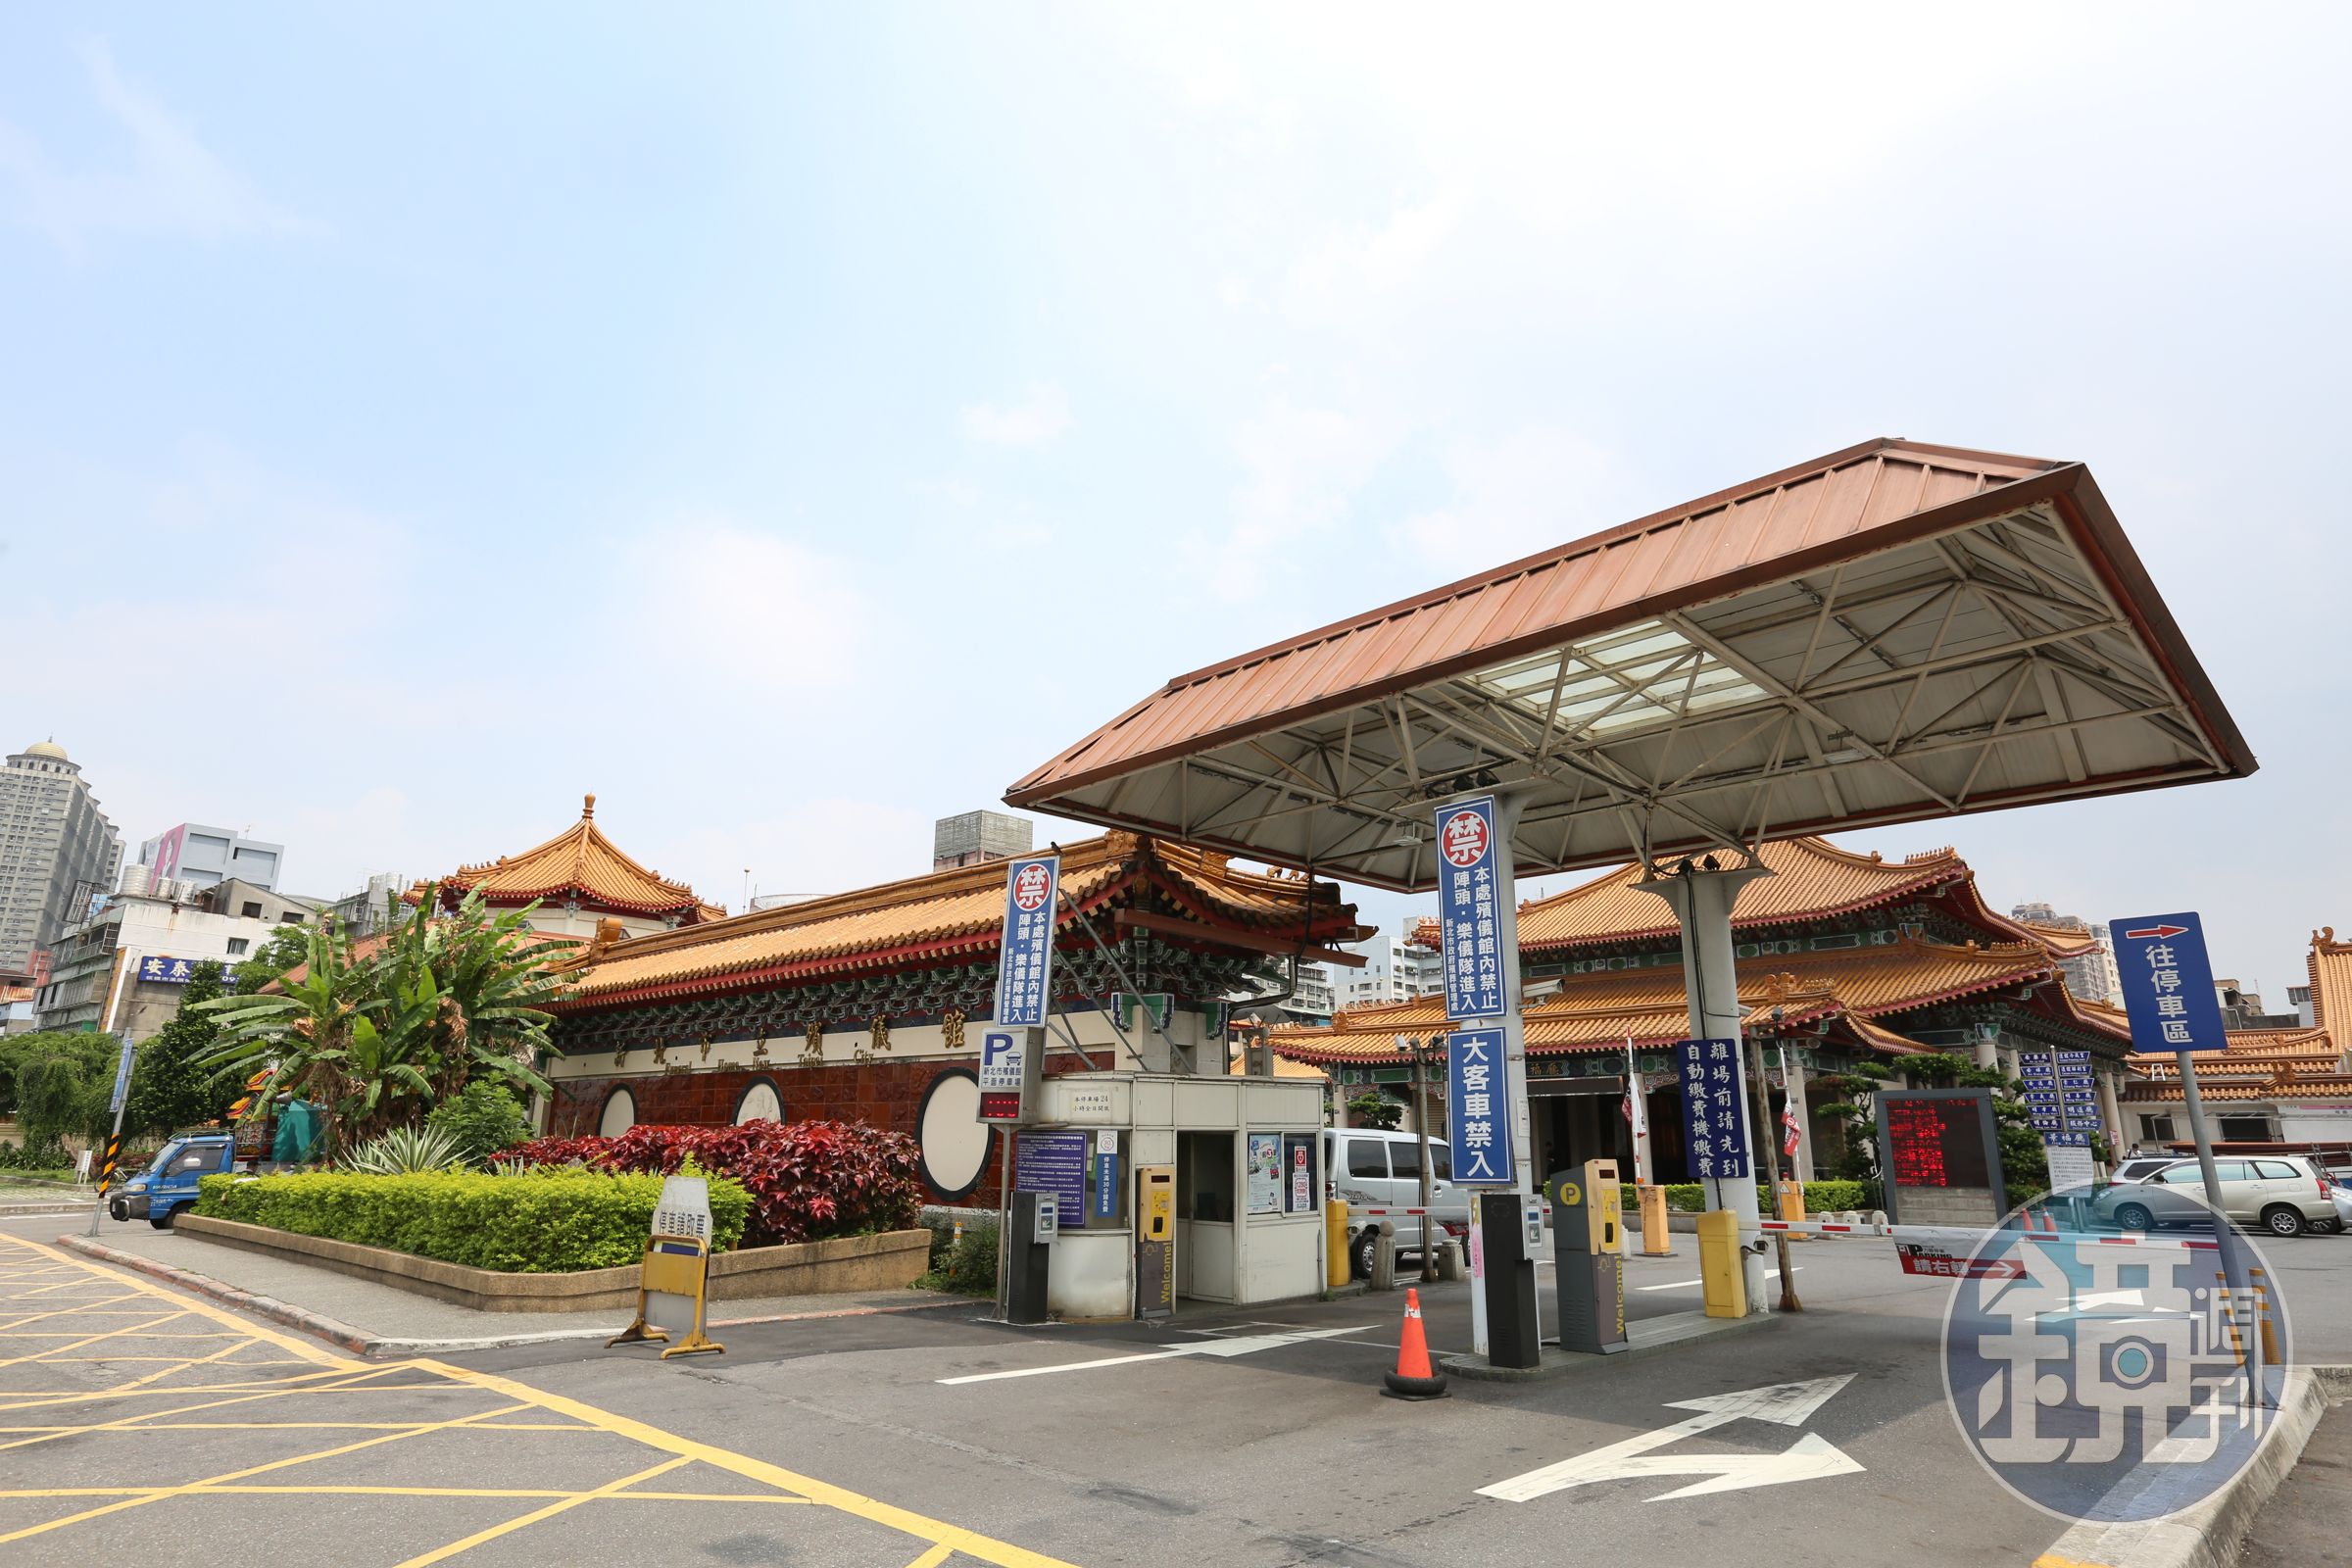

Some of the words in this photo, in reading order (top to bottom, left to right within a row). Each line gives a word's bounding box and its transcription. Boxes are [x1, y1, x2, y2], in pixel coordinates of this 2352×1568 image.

[1448, 815, 1482, 862] 禁
[1019, 867, 1046, 906] 禁
[1025, 911, 1046, 1022] 本處殯儀館內禁止
[1474, 866, 1498, 1009] 本處殯儀館內禁止
[2145, 944, 2193, 1043] 往停車區
[984, 1034, 1013, 1066] P
[1462, 1036, 1494, 1177] 大客車禁入
[1687, 1044, 1715, 1177] 自動繳費機繳費
[1709, 1042, 1740, 1177] 離場前請先到
[1565, 1187, 1577, 1201] P
[1160, 1242, 1172, 1303] Welcome!
[1614, 1255, 1625, 1334] Welcome!
